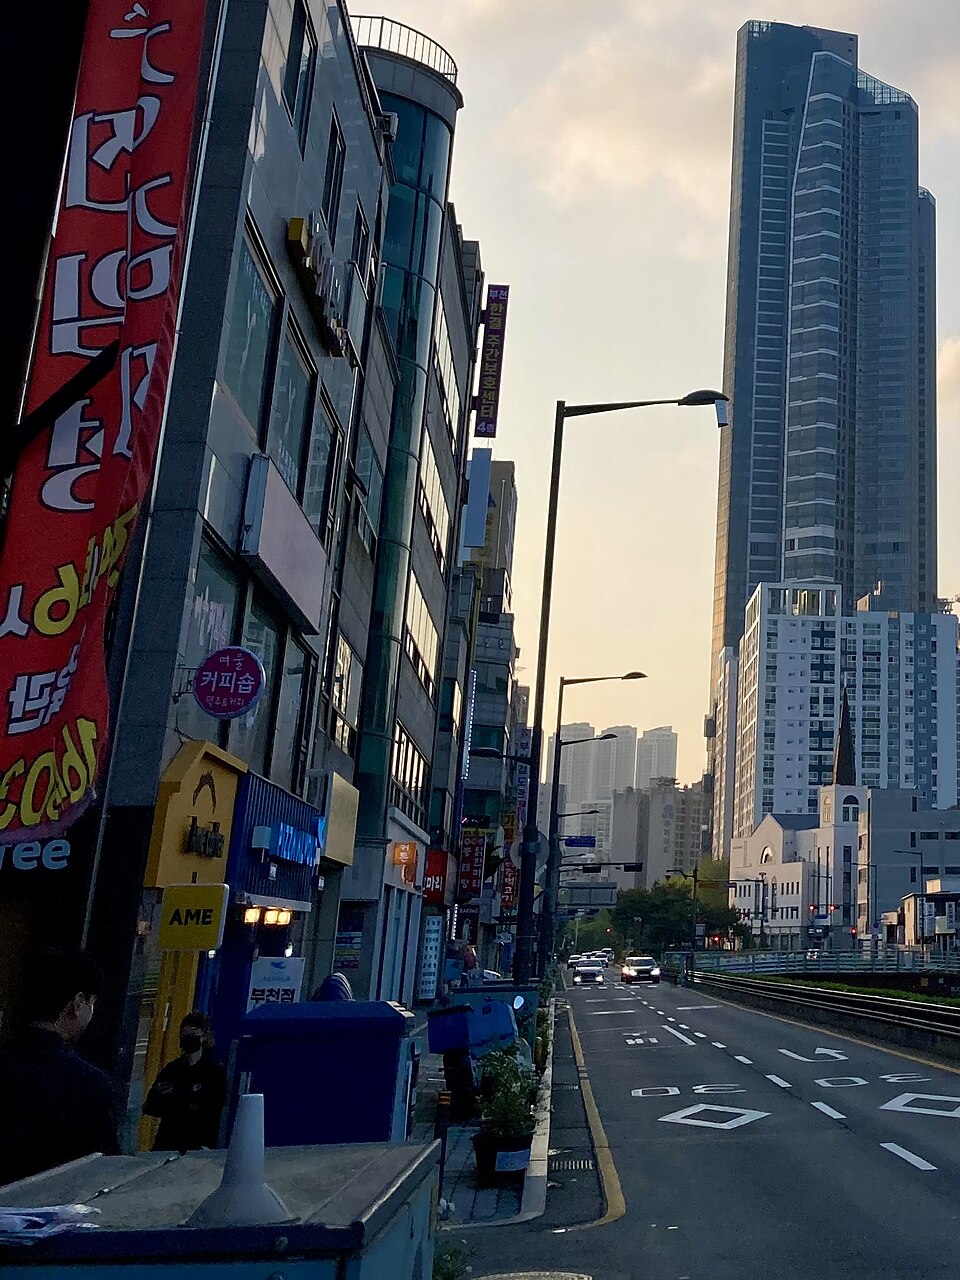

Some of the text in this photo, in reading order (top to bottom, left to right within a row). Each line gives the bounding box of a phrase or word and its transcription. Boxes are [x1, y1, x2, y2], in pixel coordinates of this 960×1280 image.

[200, 671, 255, 694] 커피숍
[423, 875, 443, 892] 마리
[169, 908, 214, 926] AME
